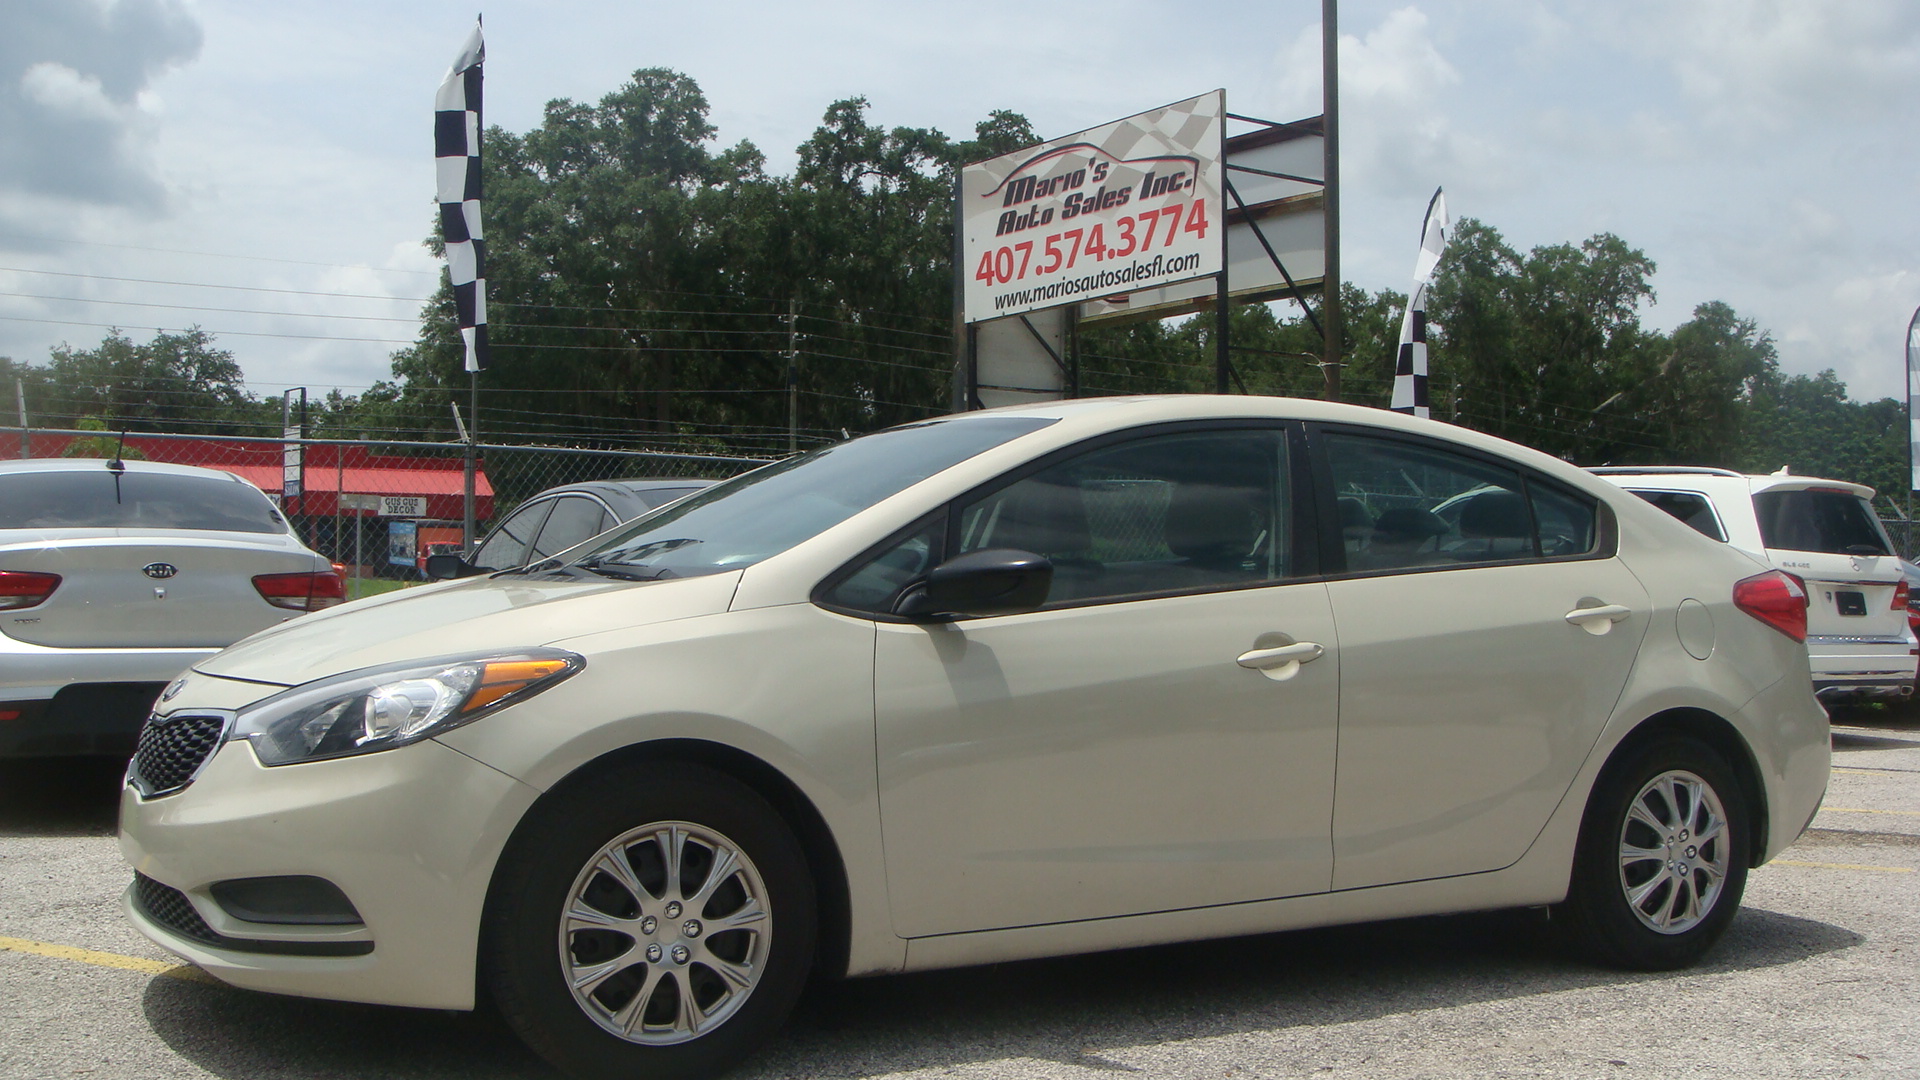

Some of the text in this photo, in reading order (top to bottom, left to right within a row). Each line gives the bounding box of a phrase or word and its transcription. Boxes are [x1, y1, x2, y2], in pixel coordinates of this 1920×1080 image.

[995, 171, 1193, 237] Auto Sales Inc.
[1003, 157, 1109, 208] Mario's
[975, 198, 1208, 287] 407.574.3774
[994, 252, 1200, 310] www.mariosautosalesfl.com
[385, 497, 418, 506] GUS GUS
[388, 505, 416, 514] DECOR
[149, 565, 173, 577] KIA
